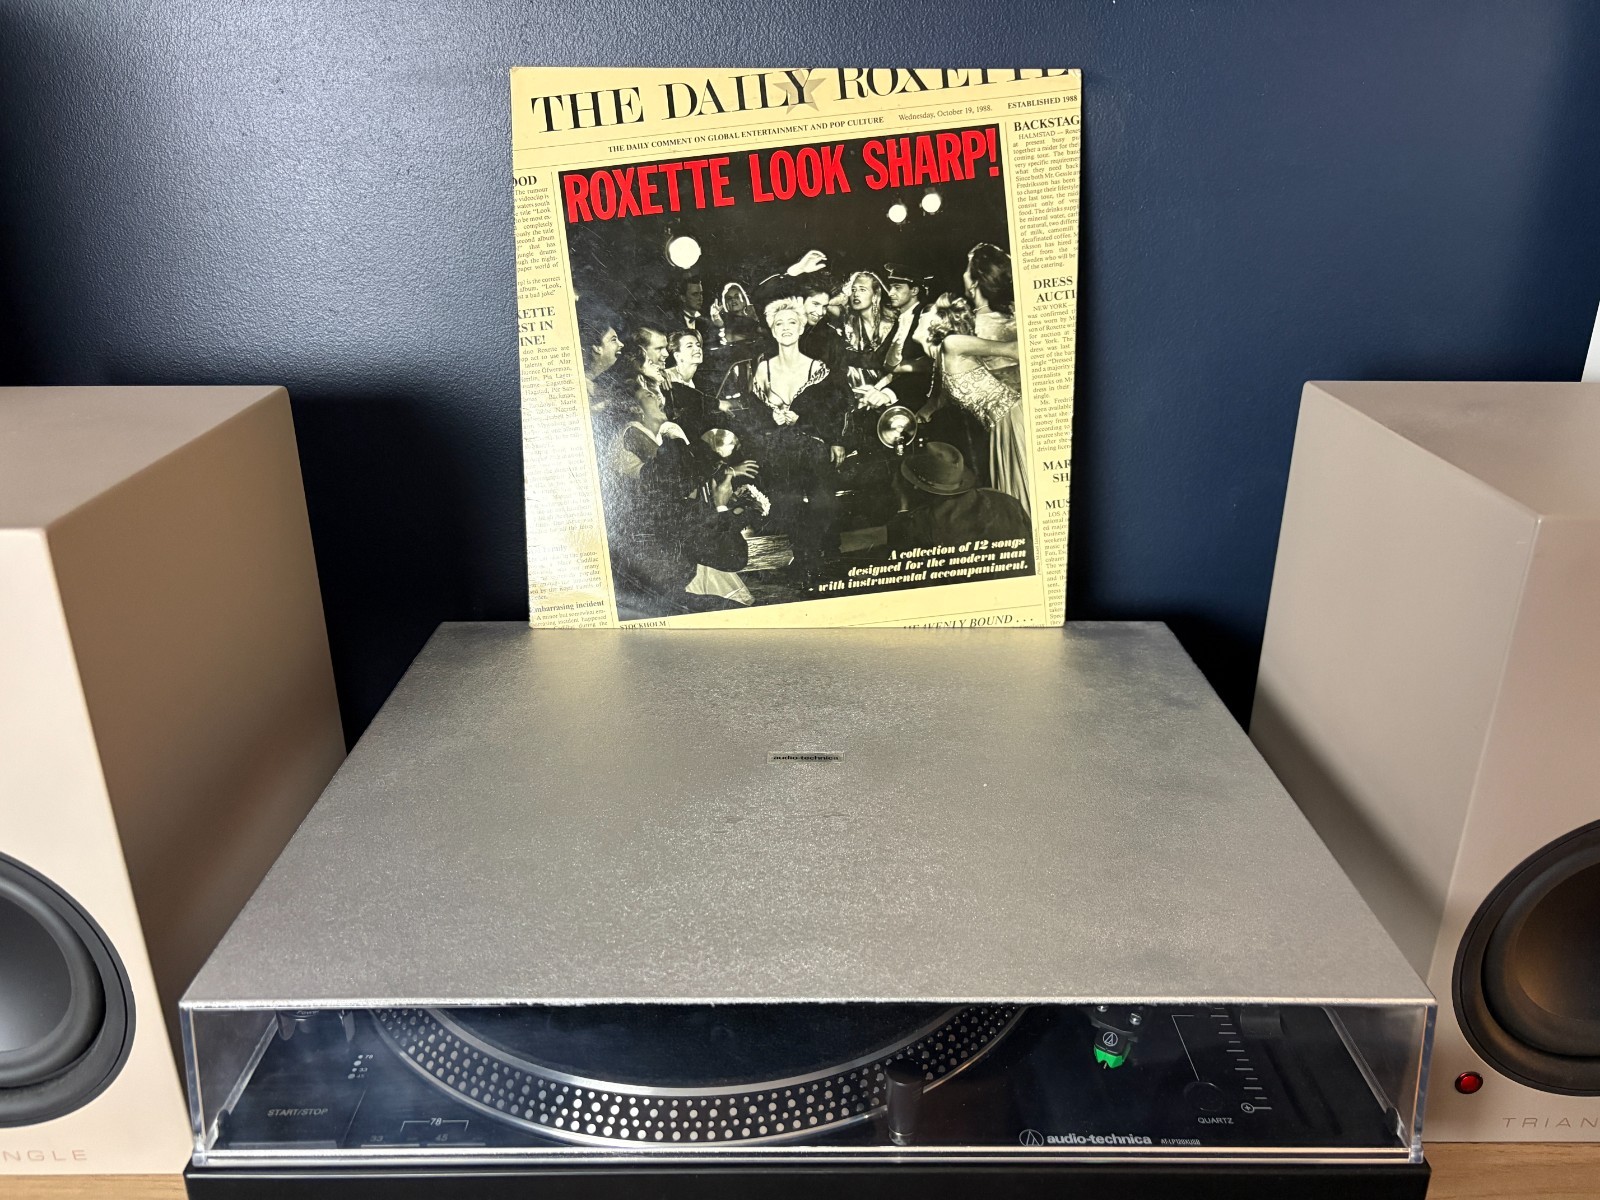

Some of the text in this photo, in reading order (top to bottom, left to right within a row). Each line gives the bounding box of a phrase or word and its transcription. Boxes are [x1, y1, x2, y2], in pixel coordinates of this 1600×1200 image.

[531, 68, 1070, 133] THE DAILY ROXE
[1007, 95, 1078, 109] ESTABLISHED 1988
[898, 104, 993, 121] Wednesday, October 19, 1988.
[608, 116, 884, 153] THE DAILY COMMENT ON GLOBAL ENTERTAINMENT AND POP CULTURE
[1018, 130, 1056, 140] HALMSTAD
[1025, 136, 1065, 147] present busy
[1013, 147, 1036, 156] together
[1013, 154, 1034, 162] coming
[1028, 159, 1049, 168] specific
[563, 128, 1000, 224] ROXETTE LOOK SHARP!
[1032, 167, 1044, 175] they
[1016, 180, 1049, 189] Fredriksson
[1023, 187, 1043, 196] change
[1041, 200, 1054, 208] only
[1022, 256, 1044, 264] Sweden
[1032, 276, 1073, 290] DRESS
[1040, 309, 1069, 318] confirmed
[519, 320, 554, 333] ST IN
[888, 537, 1026, 561] A collection of 12 songs
[847, 550, 1026, 578] designed for the modern man
[818, 580, 845, 592] with
[847, 572, 927, 589] instrumental
[930, 561, 1028, 580] accompaniment.
[576, 600, 604, 609] incident
[969, 614, 1013, 628] BOUND
[267, 1108, 328, 1117] START/STOP
[430, 1117, 442, 1126] 78
[1047, 1133, 1153, 1145] audio-technica
